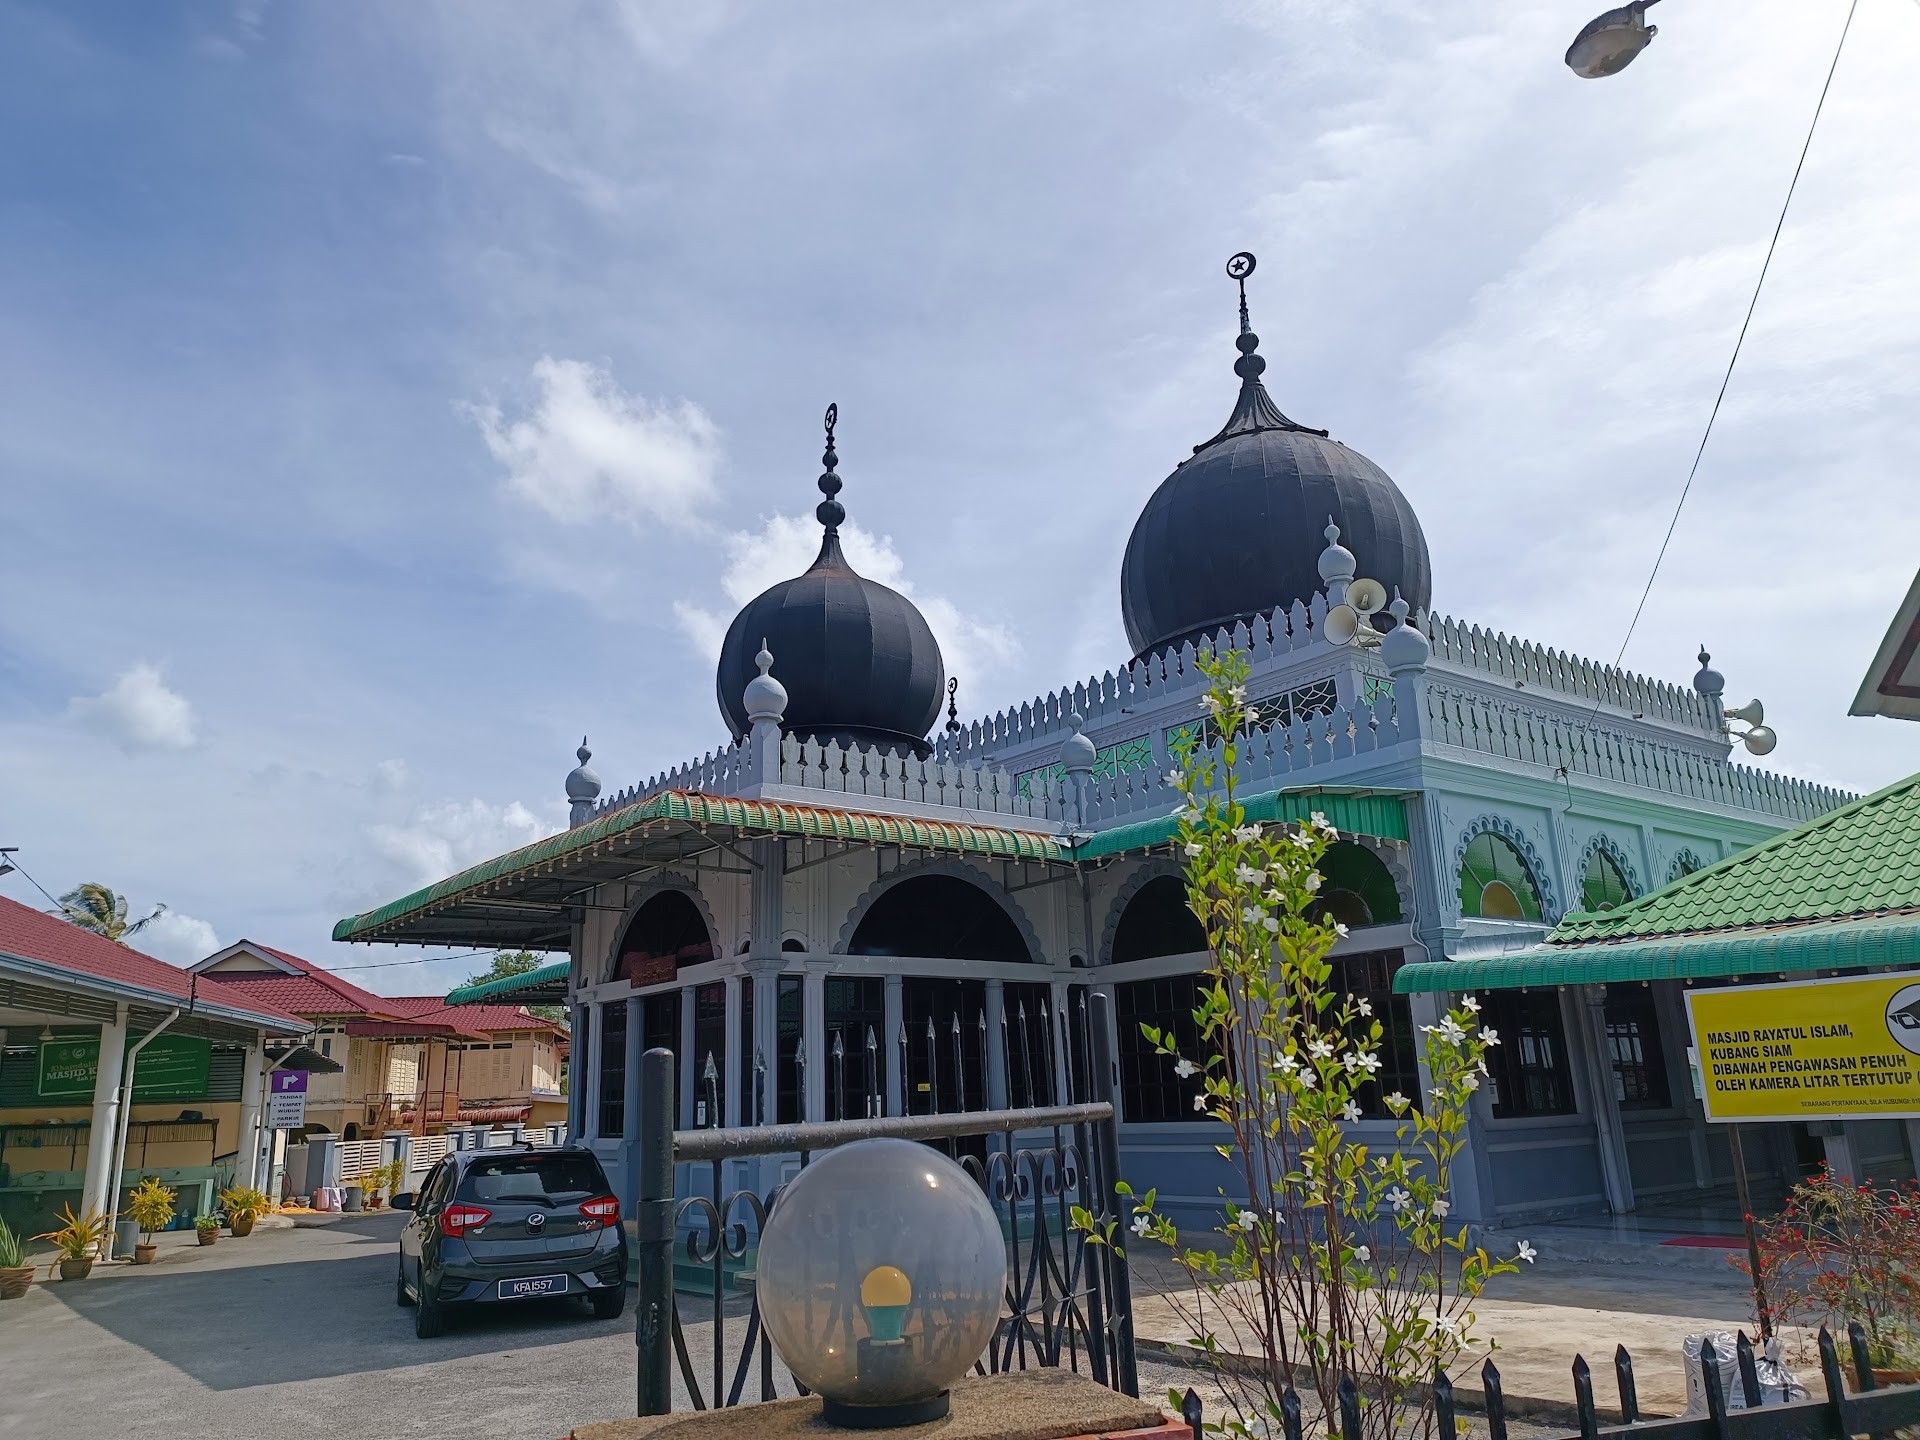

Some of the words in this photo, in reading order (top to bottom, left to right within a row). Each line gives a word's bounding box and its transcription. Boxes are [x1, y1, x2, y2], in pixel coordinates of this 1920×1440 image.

[1707, 1030, 1750, 1044] MASJID
[1753, 1027, 1807, 1041] RAYATUL
[1810, 1024, 1853, 1038] ISLAM,
[1710, 1046, 1759, 1060] KUBANG
[1762, 1044, 1792, 1057] SIAM
[46, 1068, 86, 1080] MASJID
[1713, 1062, 1767, 1075] DIBAWAH
[1770, 1056, 1857, 1073] PENGAWASAN
[1860, 1054, 1907, 1068] PENUH
[1715, 1078, 1746, 1091] OLEH
[1749, 1076, 1801, 1090] KAMERA
[1803, 1075, 1840, 1088] LITAR
[1842, 1071, 1912, 1086] TERTUTUP
